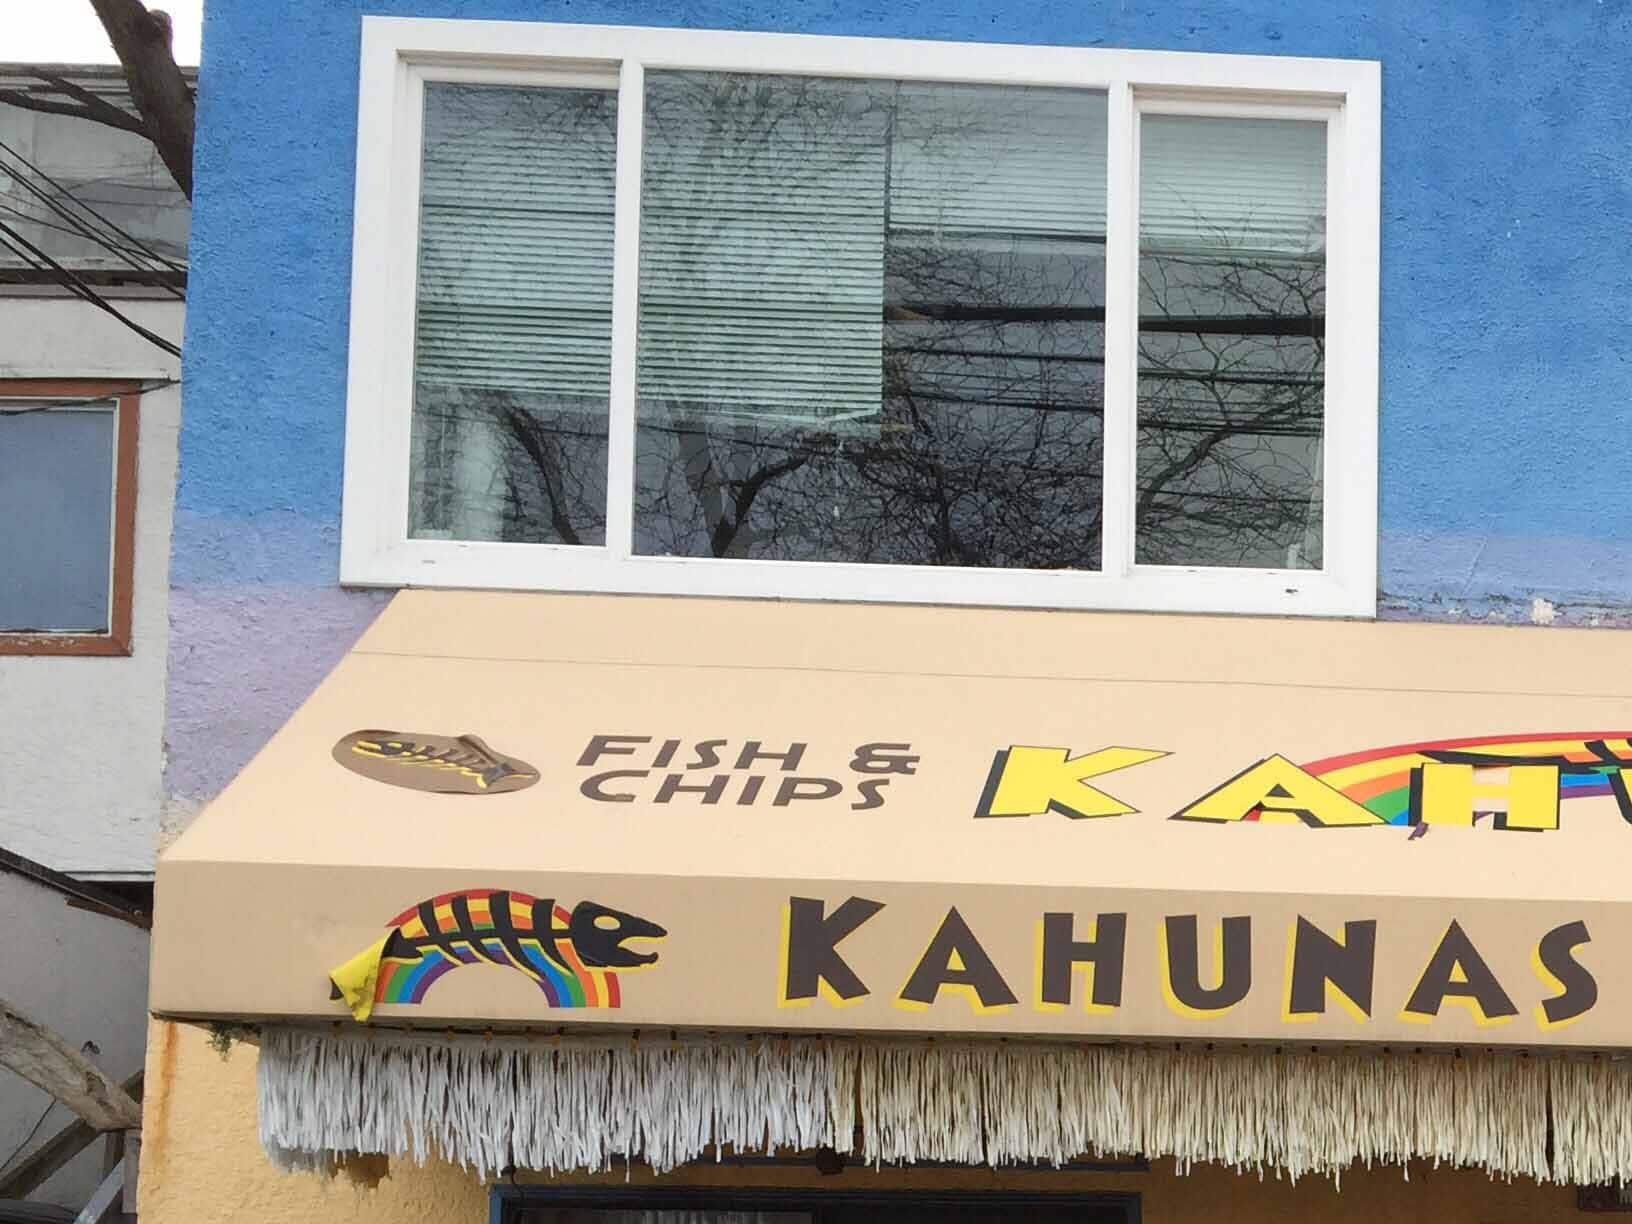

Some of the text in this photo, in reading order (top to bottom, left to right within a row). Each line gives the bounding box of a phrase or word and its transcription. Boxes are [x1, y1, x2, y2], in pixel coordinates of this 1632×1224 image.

[575, 735, 921, 775] FISH &
[578, 769, 891, 811] CHIPS
[777, 896, 1600, 1030] KAHUNAS
